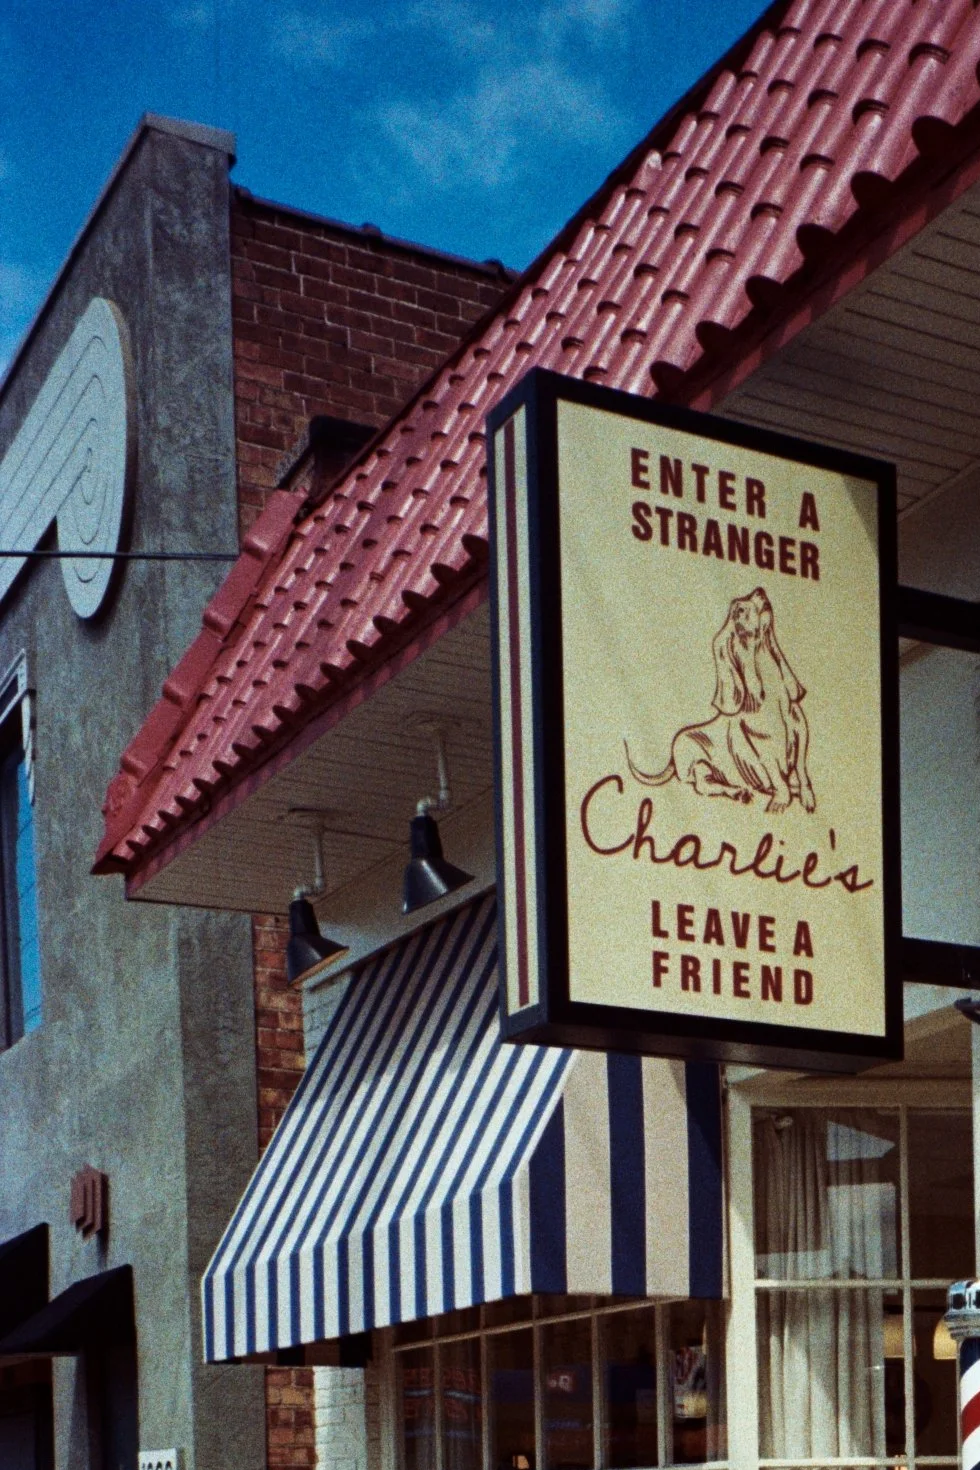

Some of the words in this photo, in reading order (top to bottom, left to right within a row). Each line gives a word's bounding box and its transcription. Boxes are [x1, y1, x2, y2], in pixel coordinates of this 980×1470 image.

[629, 446, 768, 519] ENTER
[797, 490, 822, 533] A
[630, 500, 822, 582] STRANGER
[580, 774, 875, 894] Charlie's
[650, 899, 777, 955] LEAVE
[792, 919, 815, 958] A
[651, 949, 815, 1007] FRIEND
